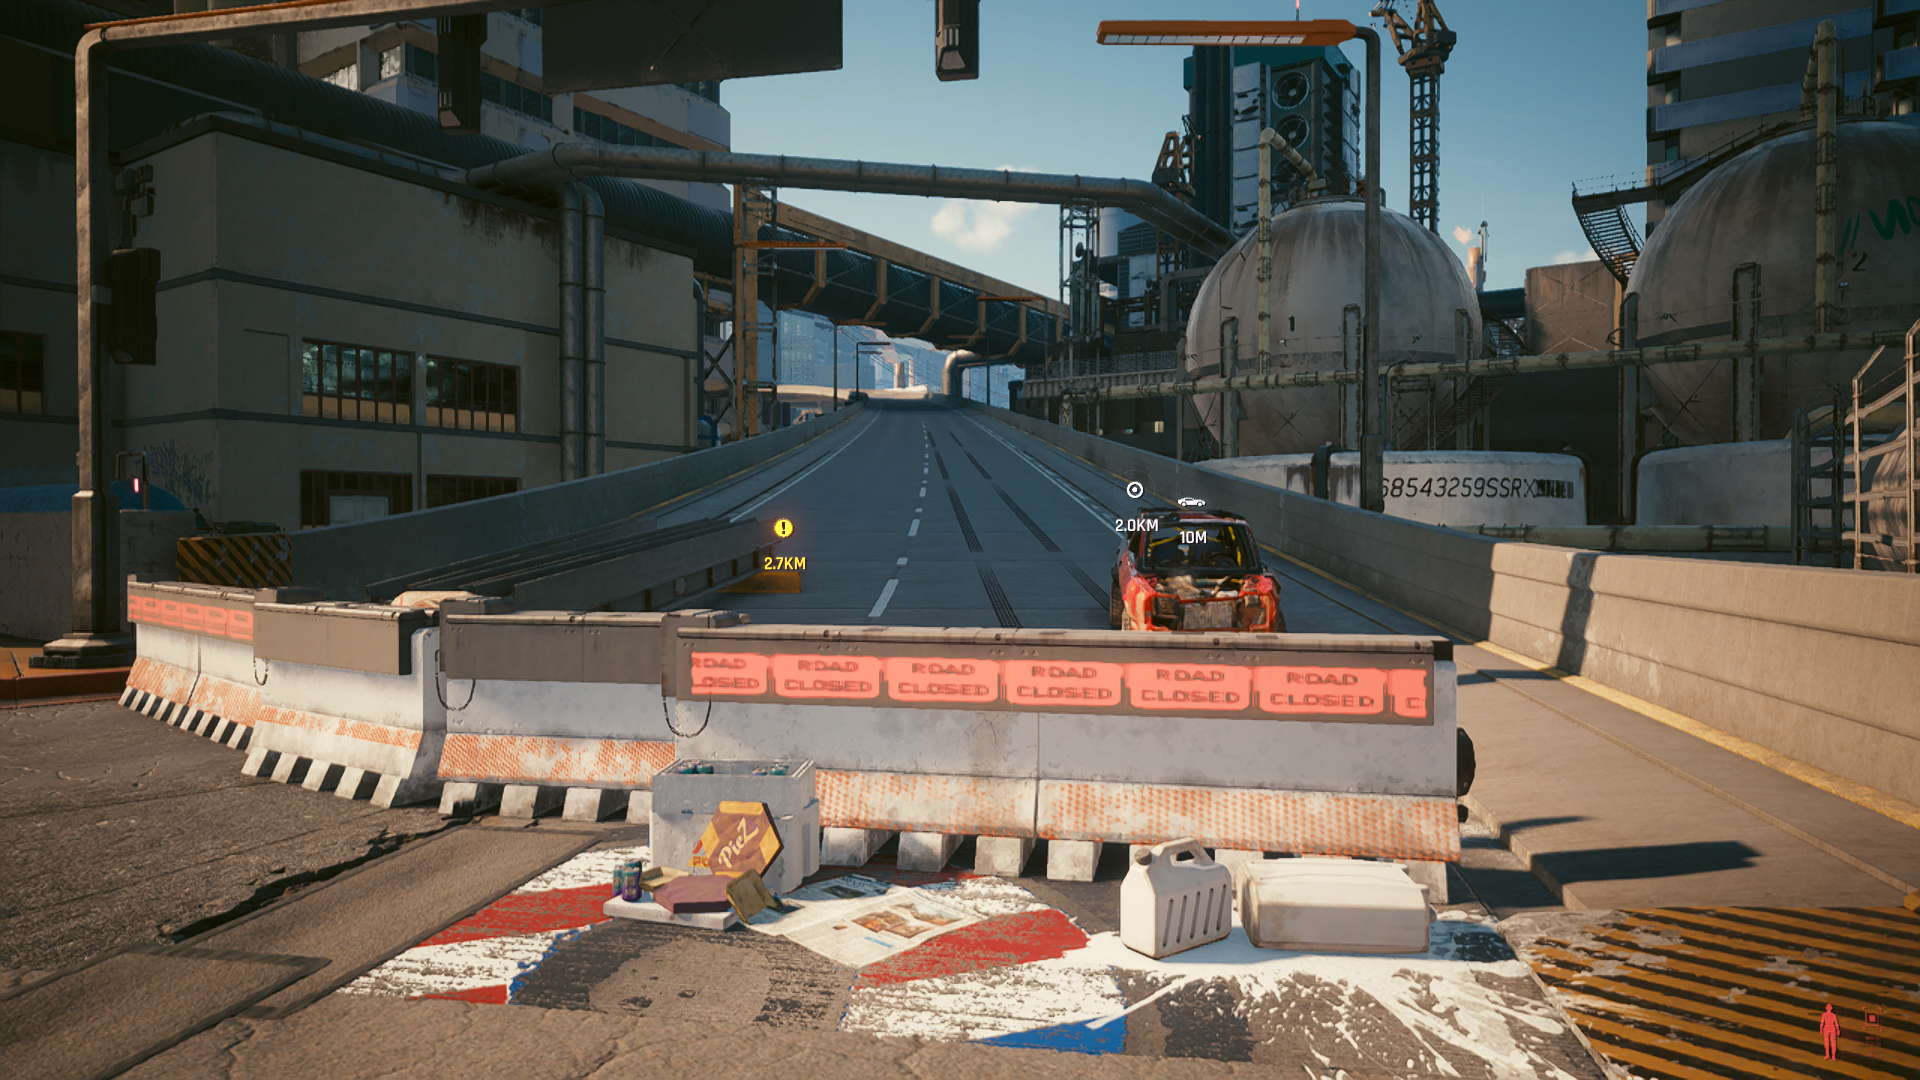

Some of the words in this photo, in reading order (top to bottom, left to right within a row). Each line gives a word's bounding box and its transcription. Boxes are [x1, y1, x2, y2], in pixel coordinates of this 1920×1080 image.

[1851, 251, 1868, 272] 2
[1287, 315, 1295, 332] 1
[798, 659, 858, 672] ROAD
[912, 662, 975, 675] ROAD
[1032, 666, 1097, 679] ROAD
[1156, 669, 1225, 682] ROAD
[1287, 672, 1358, 686] ROAD
[784, 679, 872, 692] CLOSED
[898, 682, 989, 696] CLOSED
[1017, 685, 1112, 699] CLOSED
[1141, 689, 1240, 704] CLOSED
[1270, 693, 1375, 708] CLOSED
